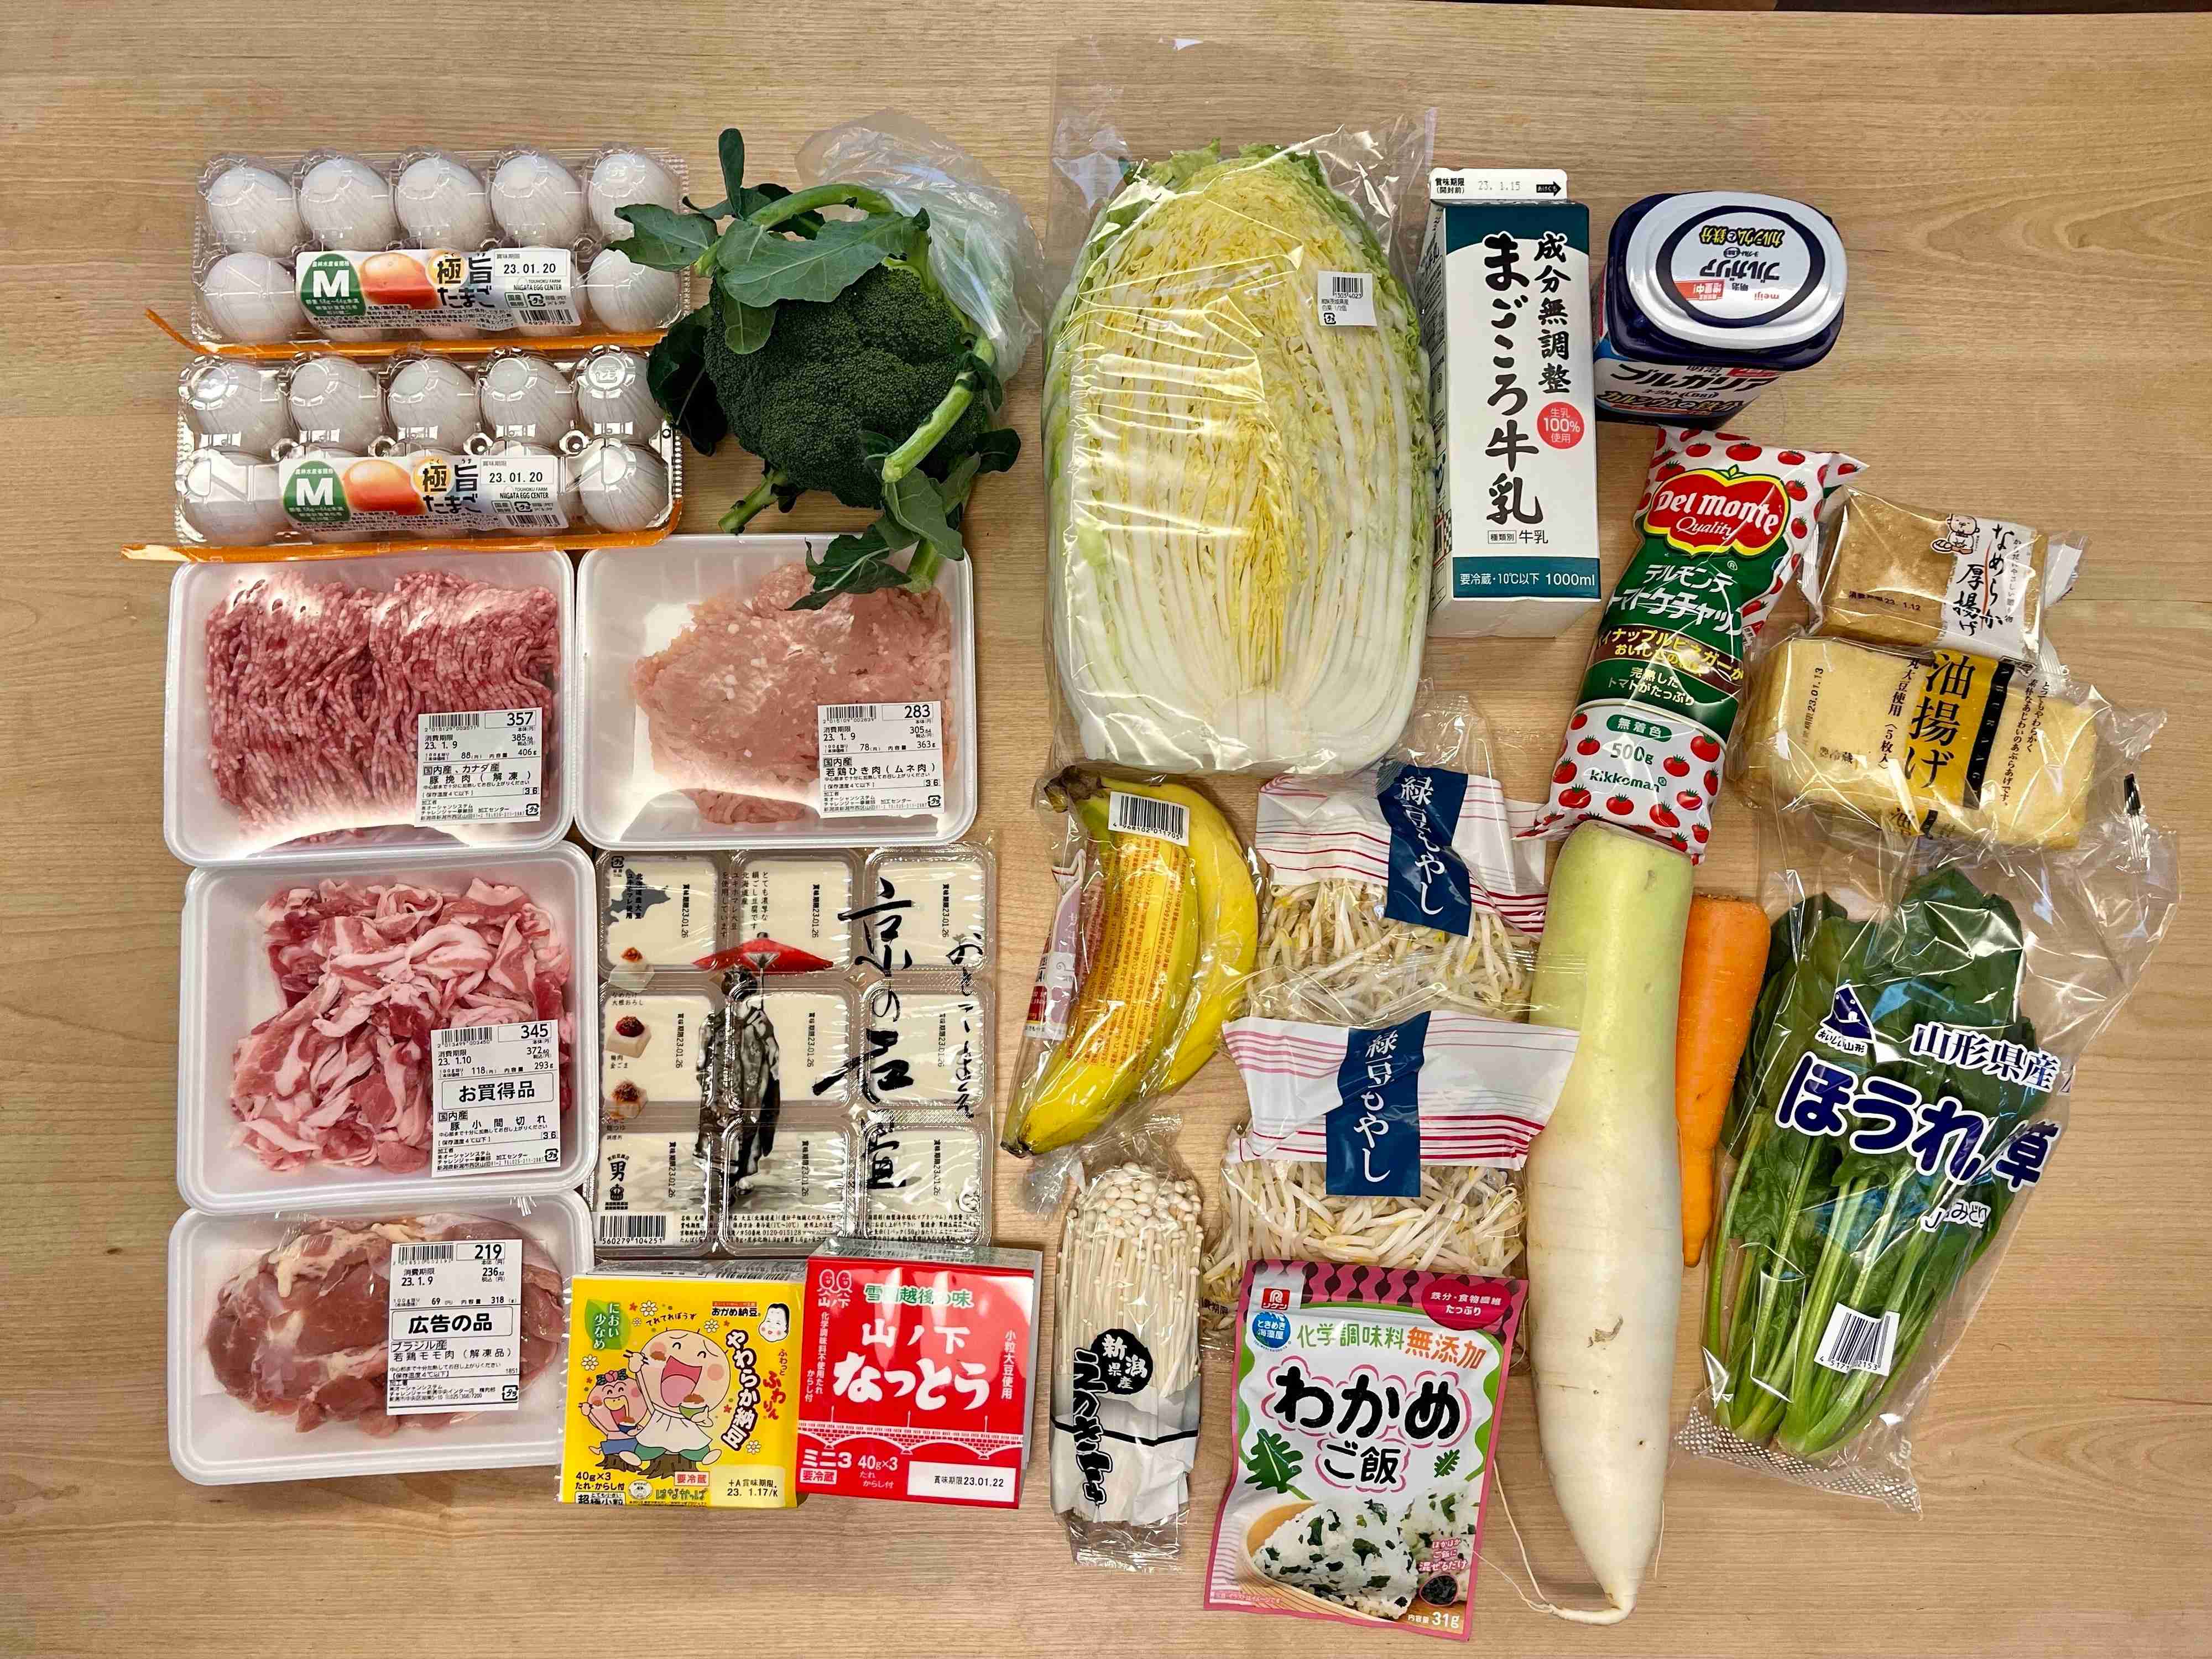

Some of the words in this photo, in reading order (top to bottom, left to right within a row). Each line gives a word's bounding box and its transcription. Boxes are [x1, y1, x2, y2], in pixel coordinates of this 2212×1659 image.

[1434, 178, 1465, 187] 賞味期限
[1436, 186, 1465, 195] (開封前)
[1699, 225, 1786, 248] カルシウムと鉄分
[437, 258, 492, 284] 極旨
[503, 263, 556, 274] 23.01.20
[1700, 258, 1780, 283] ブルガリア
[313, 270, 349, 298] M
[1693, 283, 1722, 294] 増量中!
[1732, 282, 1749, 291] 明治
[437, 285, 495, 309] たまご
[1754, 291, 1779, 300] meiji
[1533, 233, 1572, 393] 成分無調整
[1484, 233, 1543, 525] まごころ牛乳
[1610, 363, 1780, 392] ブルガリア
[1551, 408, 1571, 418] 生乳
[1543, 418, 1580, 433] 100%
[1551, 433, 1571, 444] 使用
[422, 465, 478, 492] 極旨
[489, 472, 543, 483] 23.01.20
[296, 477, 333, 505] M
[423, 493, 482, 514] たまご
[1654, 490, 1697, 513] Del
[1696, 494, 1780, 536] Monte
[1490, 533, 1515, 541] 種類別
[1519, 530, 1548, 544] 牛乳
[1676, 516, 1735, 540] Quality
[1459, 572, 1540, 585] 要冷蔵・10℃以下
[1545, 573, 1595, 586] 1000ml
[1642, 564, 1738, 593] デルモンテ
[1989, 523, 2015, 629] なめらか
[1952, 564, 1987, 636] 厚揚げ
[1630, 667, 1679, 688] 完熟した
[1888, 658, 1921, 717] 丸大豆使用
[1608, 676, 1695, 706] トマトがたっぷり
[507, 712, 534, 726] 357
[905, 704, 931, 718] 283
[1905, 653, 1977, 789] 油揚げ
[2026, 681, 2050, 753] とってもやわらかく
[1618, 718, 1661, 737] 無着色
[2000, 679, 2038, 806] 素朴なあじわいのあぶらあげです。
[823, 757, 852, 768] 国内産
[1610, 742, 1654, 765] 500g
[423, 763, 500, 775] 国内産、カナダ産
[1589, 769, 1660, 792] kikkoman
[1154, 828, 1180, 840] 011705
[1400, 777, 1446, 916] 緑豆もやし
[521, 1024, 548, 1039] 345
[1818, 1029, 1865, 1053] おいしい山形
[438, 1049, 467, 1057] 消費期限
[1911, 1022, 2061, 1093] 山形県産
[459, 1080, 535, 1102] お買得品
[438, 1110, 468, 1122] 国内産
[1353, 1029, 1399, 1183] 緑豆もやし
[450, 1115, 546, 1131] 豚小間切れ
[1777, 1051, 2062, 1191] ほうれ草
[611, 1160, 627, 1182] 男
[474, 1244, 502, 1259] 219
[404, 1267, 435, 1276] 消費期限
[818, 1297, 851, 1308] 山ノ下
[1430, 1291, 1503, 1306] 鉄分・食物繊維
[609, 1303, 619, 1337] におい
[712, 1308, 758, 1317] おかめ納豆
[1445, 1305, 1482, 1317] たっぷり
[408, 1313, 492, 1334] 広告の品
[593, 1313, 606, 1349] 少なめ
[1257, 1320, 1286, 1331] ときめき
[392, 1340, 447, 1352] ブラジル産
[861, 1318, 971, 1354] 山ノ下
[1296, 1322, 1404, 1350] 化学調味料
[1405, 1326, 1486, 1370] 無添加
[779, 1349, 787, 1376] ふわっと
[815, 1311, 829, 1395] 化学調味料不使用たれ
[1000, 1330, 1017, 1400] 小粒大豆使用
[721, 1329, 761, 1451] やわらか納豆
[805, 1369, 815, 1402] からし付
[833, 1350, 990, 1411] なっとう
[763, 1371, 786, 1420] ふわりん
[1274, 1365, 1461, 1440] わかめ
[802, 1448, 853, 1468] ミニ3
[1323, 1441, 1401, 1485] ご飯
[576, 1482, 625, 1490] たれ・からし付
[676, 1474, 707, 1484] 要冷蔵
[802, 1470, 835, 1482] 要冷蔵
[863, 1480, 894, 1489] からし付
[656, 1488, 708, 1500] はなかっぱ
[1432, 1537, 1461, 1549] ほかほか
[1433, 1549, 1458, 1559] ご飯に
[1418, 1559, 1468, 1572] 混ぜるだけ
[1407, 1614, 1430, 1624] 内容量
[1432, 1610, 1460, 1629] 31g
